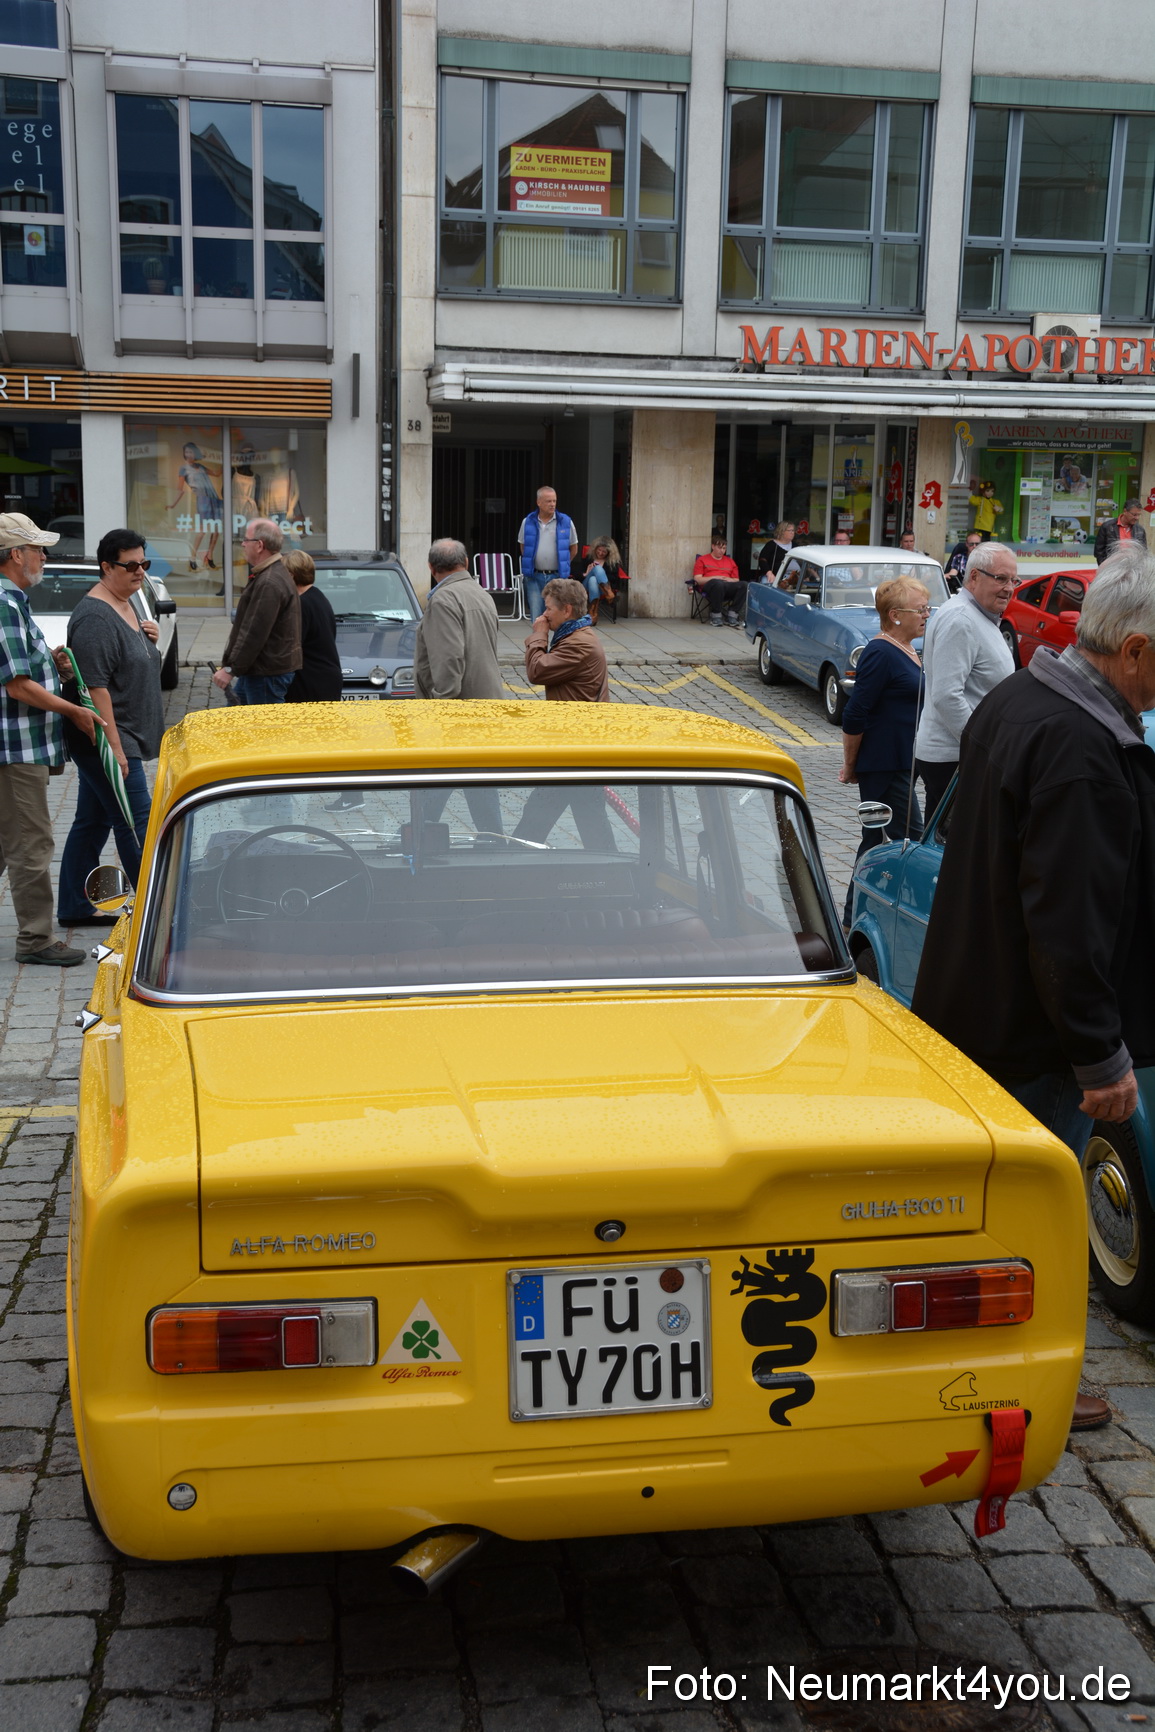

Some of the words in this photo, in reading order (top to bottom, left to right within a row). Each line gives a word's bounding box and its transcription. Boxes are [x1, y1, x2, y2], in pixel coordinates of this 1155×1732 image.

[515, 152, 532, 163] ZU
[536, 154, 607, 167] VERMIETEN
[540, 165, 557, 173] BÜRO
[561, 167, 606, 176] PRAXISFLÄCHE
[529, 181, 558, 190] KIRSCH
[567, 184, 606, 193] HAUBNER
[529, 190, 568, 198] IMMOBILIEN
[407, 419, 422, 432] 38
[987, 424, 1046, 438] MARIEN
[1053, 426, 1134, 441] APOTHEKE
[842, 1201, 898, 1220] GIULIA
[948, 1195, 966, 1214] TI
[230, 1236, 286, 1257] ALFA
[293, 1231, 376, 1254] ROMEO
[562, 1276, 639, 1337] FÜ
[523, 1315, 535, 1332] D
[382, 1368, 414, 1384] Alfa
[415, 1365, 462, 1378] Romeo
[962, 1398, 1020, 1412] LAUSITZRING
